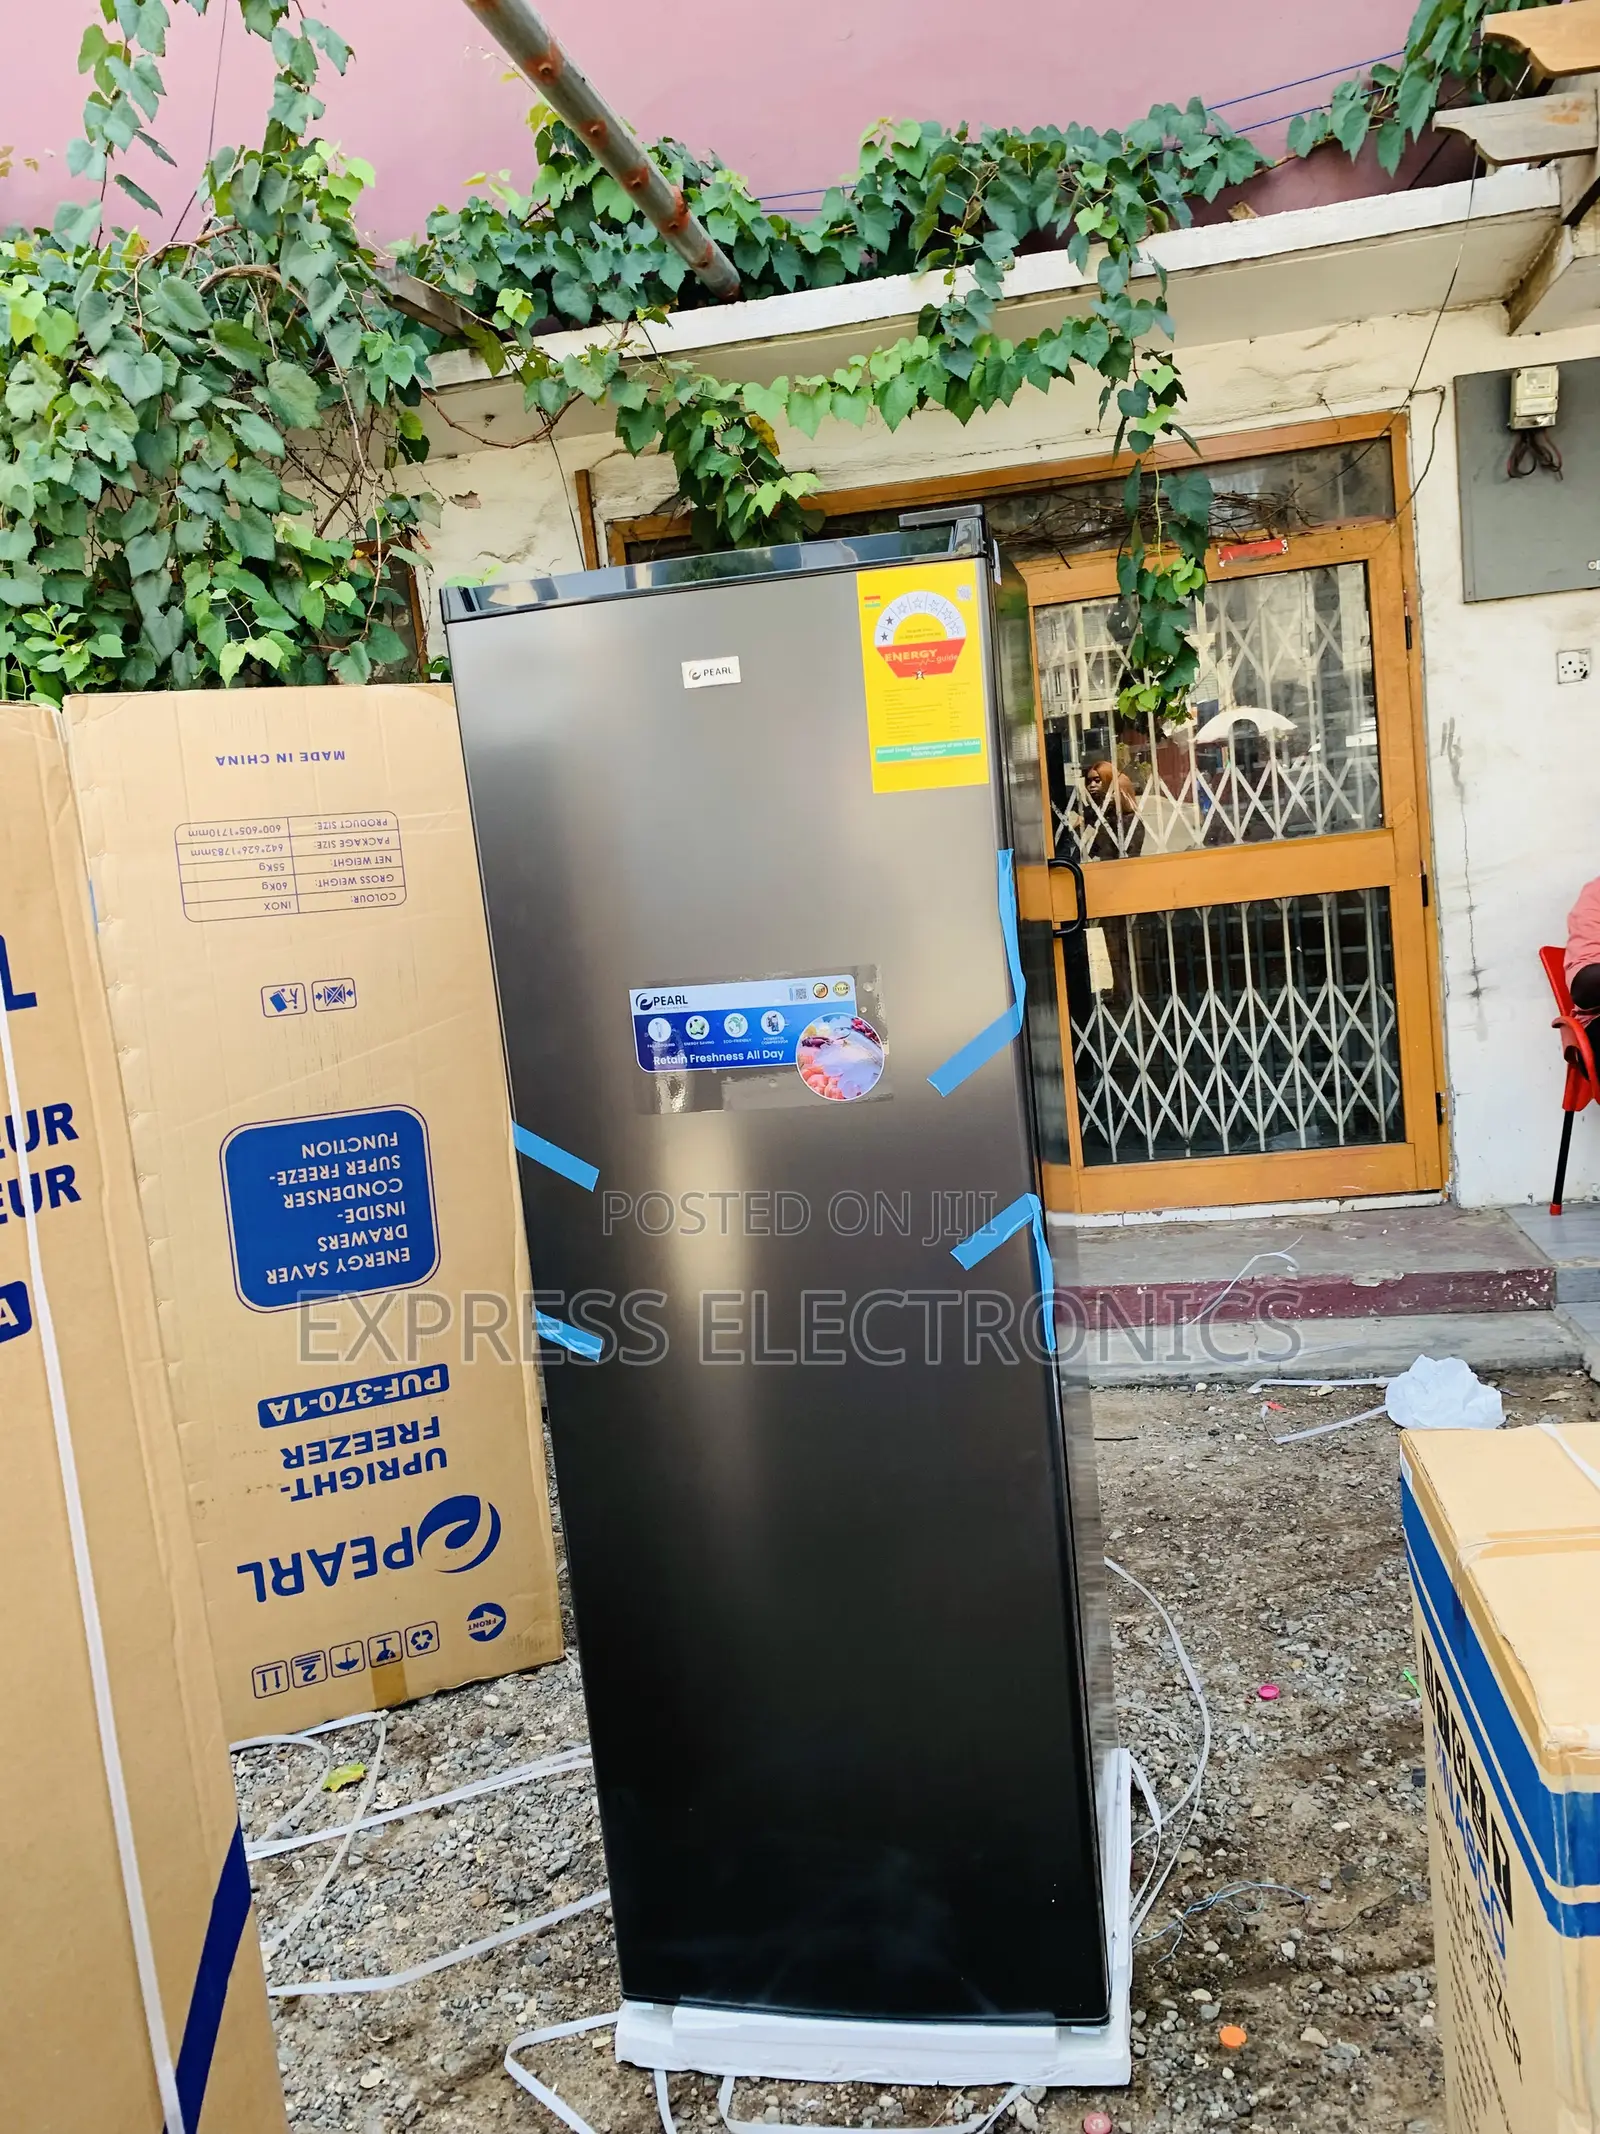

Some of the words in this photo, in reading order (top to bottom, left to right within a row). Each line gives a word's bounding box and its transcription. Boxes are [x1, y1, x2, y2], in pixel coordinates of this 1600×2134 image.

[885, 649, 938, 662] ENERGY
[936, 654, 958, 664] guide
[703, 667, 732, 676] PEARL
[215, 753, 269, 766] CHINA
[275, 752, 293, 763] IN
[299, 750, 345, 762] MADE
[314, 821, 337, 831] SIZE:
[339, 818, 388, 830] PRODUCT
[313, 839, 336, 850] SIZE:
[339, 836, 390, 849] PACKAGE
[259, 861, 285, 872] 55Kg
[330, 857, 373, 868] WEIGHT:
[374, 855, 392, 864] NET
[261, 881, 288, 891] 60Kg
[315, 876, 356, 888] WEIGHT:
[358, 873, 394, 885] GROSS
[350, 892, 396, 904] COLOUR:
[263, 901, 291, 911] INOX
[653, 995, 688, 1006] PEARL
[654, 1056, 688, 1065] Retain
[690, 1052, 744, 1063] Freshness
[747, 1050, 760, 1060] All
[763, 1050, 784, 1060] Day
[0, 1102, 79, 1159] UR
[301, 1132, 399, 1159] FUNCTION
[269, 1161, 339, 1184] FREEZE-
[345, 1154, 400, 1176] SUPER
[283, 1177, 403, 1209] CONDENSER
[337, 1200, 406, 1223] INSIDE-
[317, 1224, 408, 1252] DRAWERS
[335, 1247, 411, 1273] ENERGY
[266, 1260, 329, 1284] SAVER
[268, 1369, 442, 1421] PUF-370-1A
[280, 1416, 440, 1469] FREEZER
[280, 1447, 447, 1502] UPRIGHT-
[237, 1526, 414, 1603] PEARL
[467, 1617, 497, 1632] FRONT
[1441, 1749, 1506, 1960] NASCO
[1463, 1882, 1523, 2084] FREEZER
